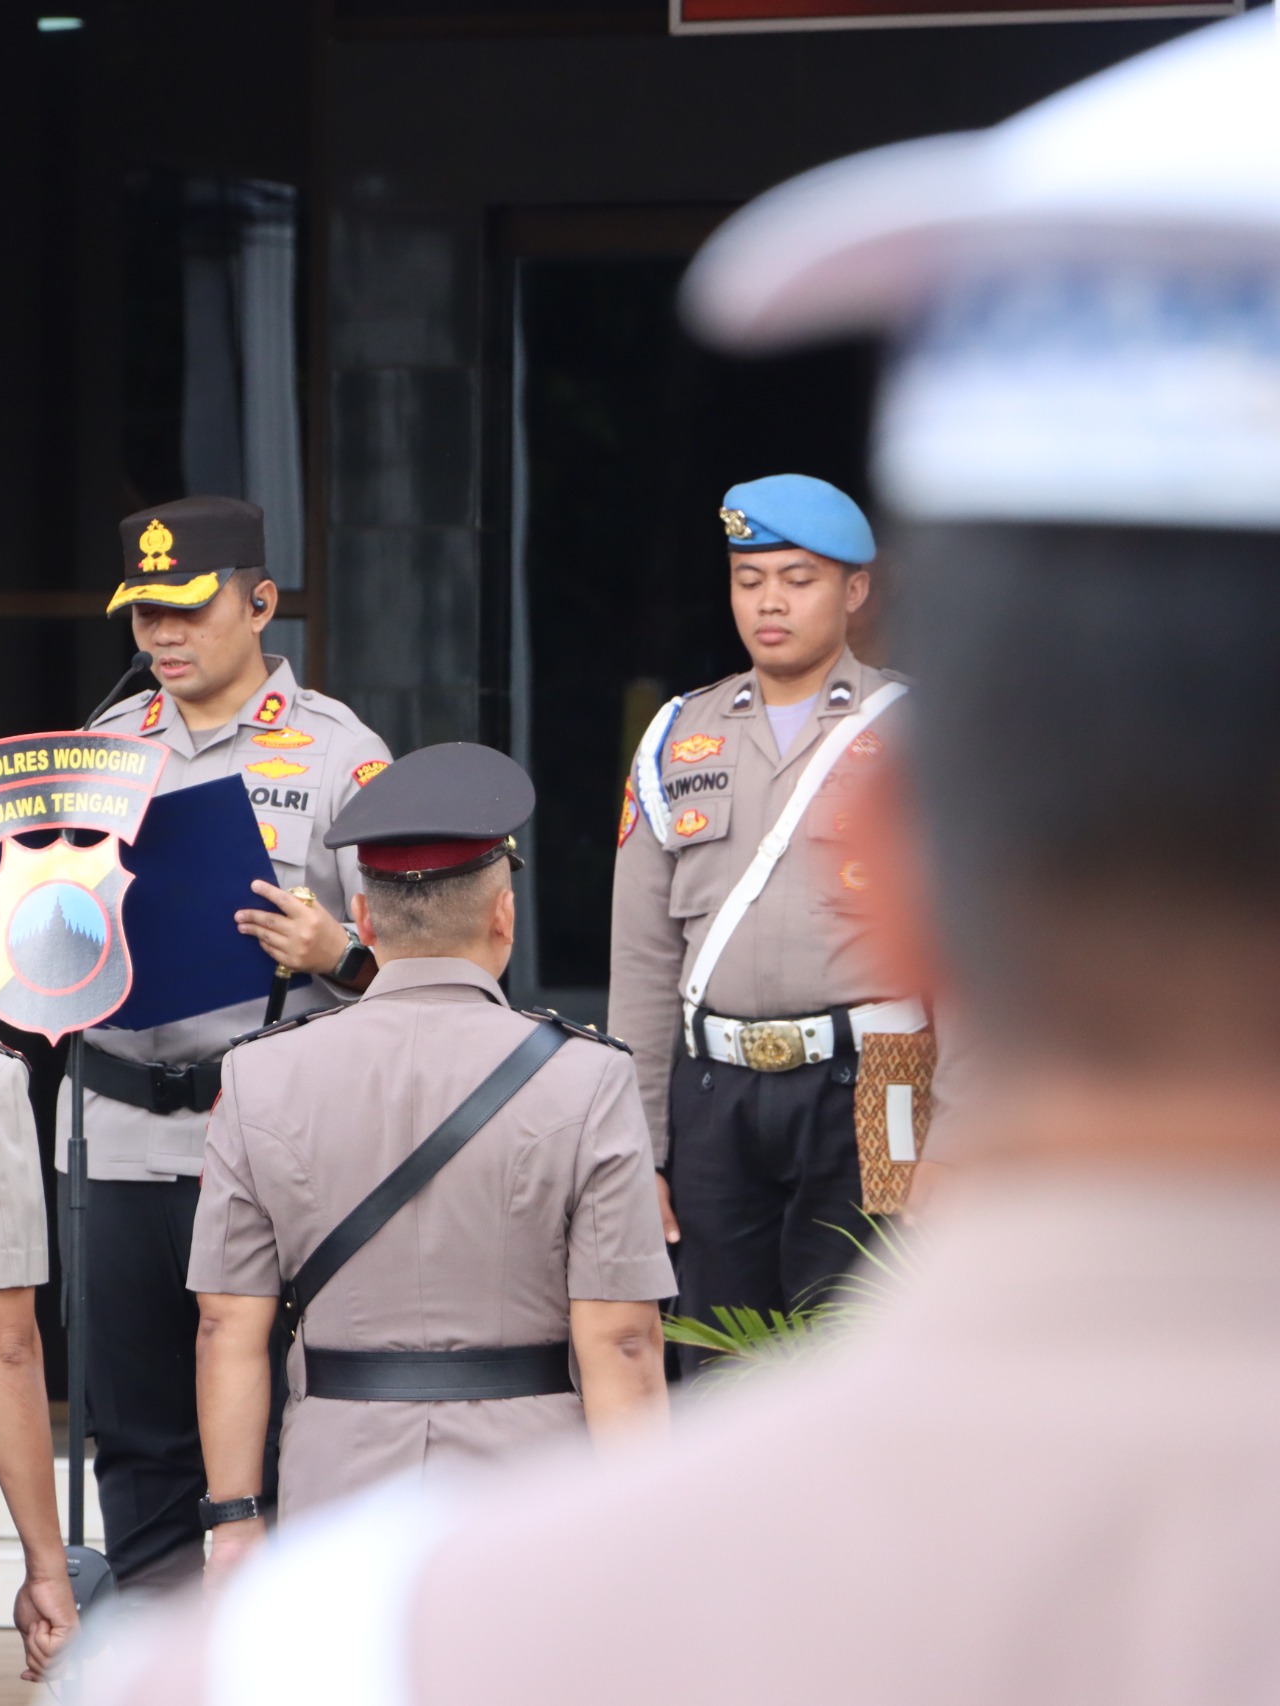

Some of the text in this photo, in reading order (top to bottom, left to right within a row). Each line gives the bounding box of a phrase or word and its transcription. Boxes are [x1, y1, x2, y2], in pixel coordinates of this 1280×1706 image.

[53, 748, 147, 775] WONOGIRI
[51, 792, 129, 817] TENGAH
[246, 787, 309, 812] OLRI
